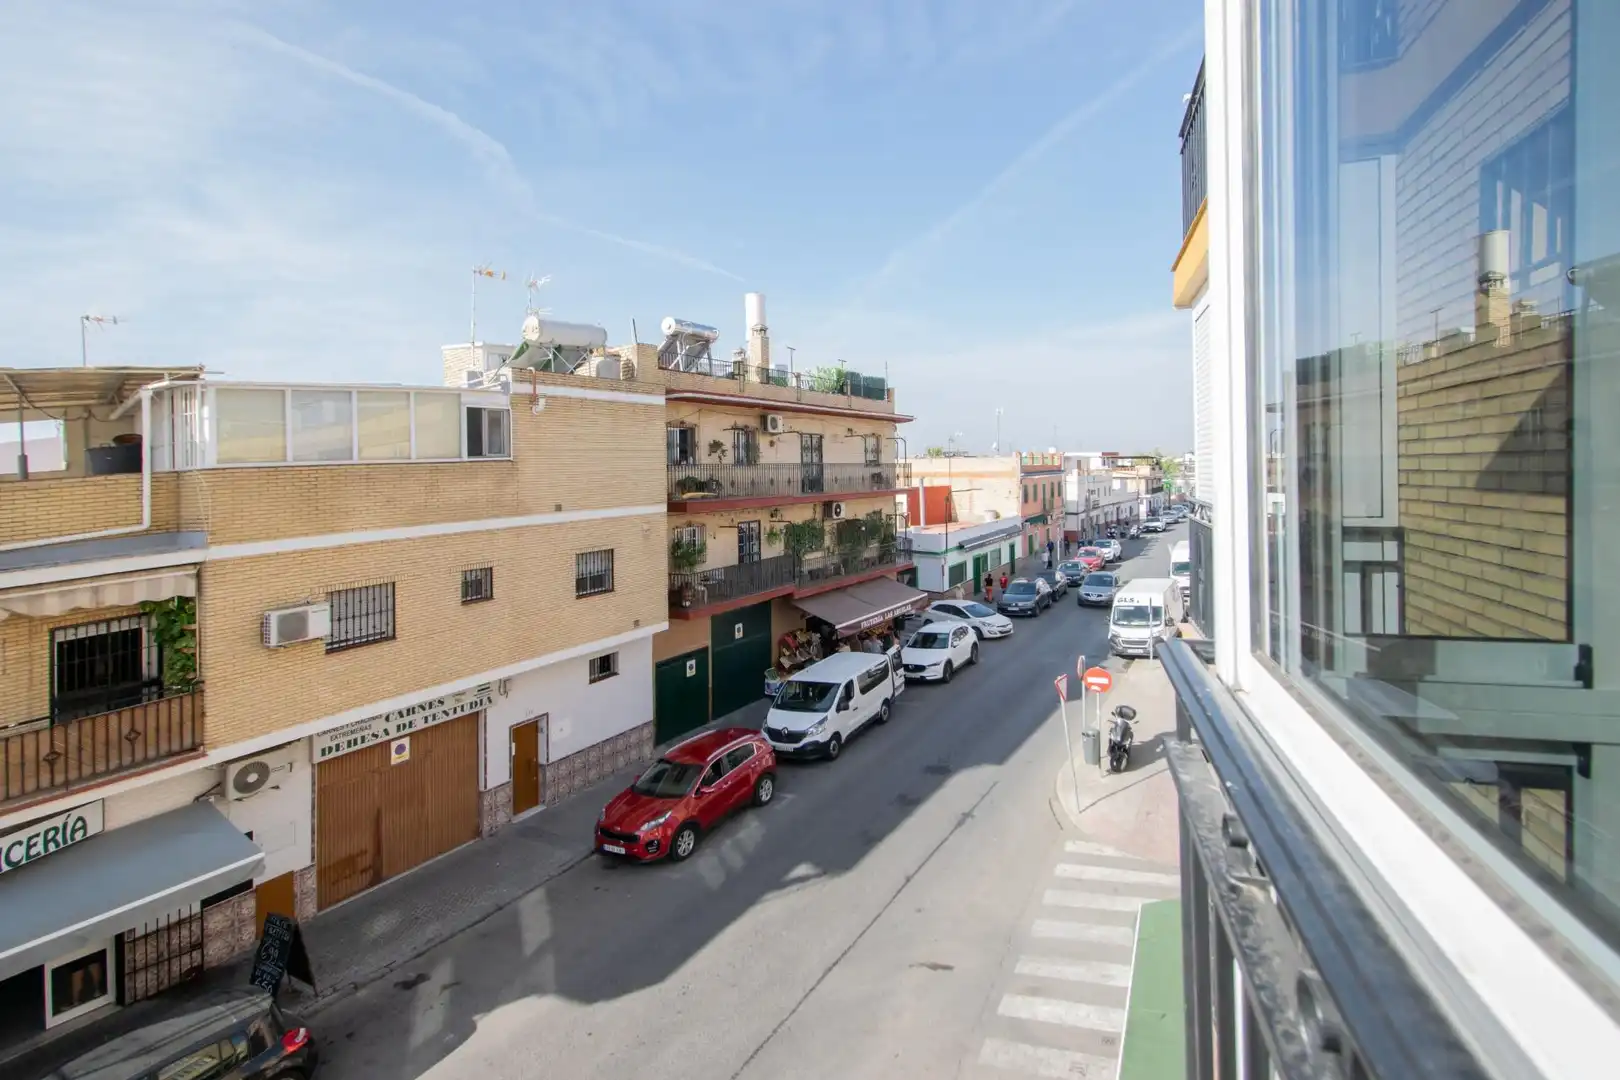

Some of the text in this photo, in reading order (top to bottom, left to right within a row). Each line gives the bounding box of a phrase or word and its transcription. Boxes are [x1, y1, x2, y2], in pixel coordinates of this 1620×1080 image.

[384, 698, 445, 723] CARNES
[320, 728, 390, 757] DEHESA
[396, 718, 417, 733] DE
[330, 724, 372, 741] EXTREMEÑAS
